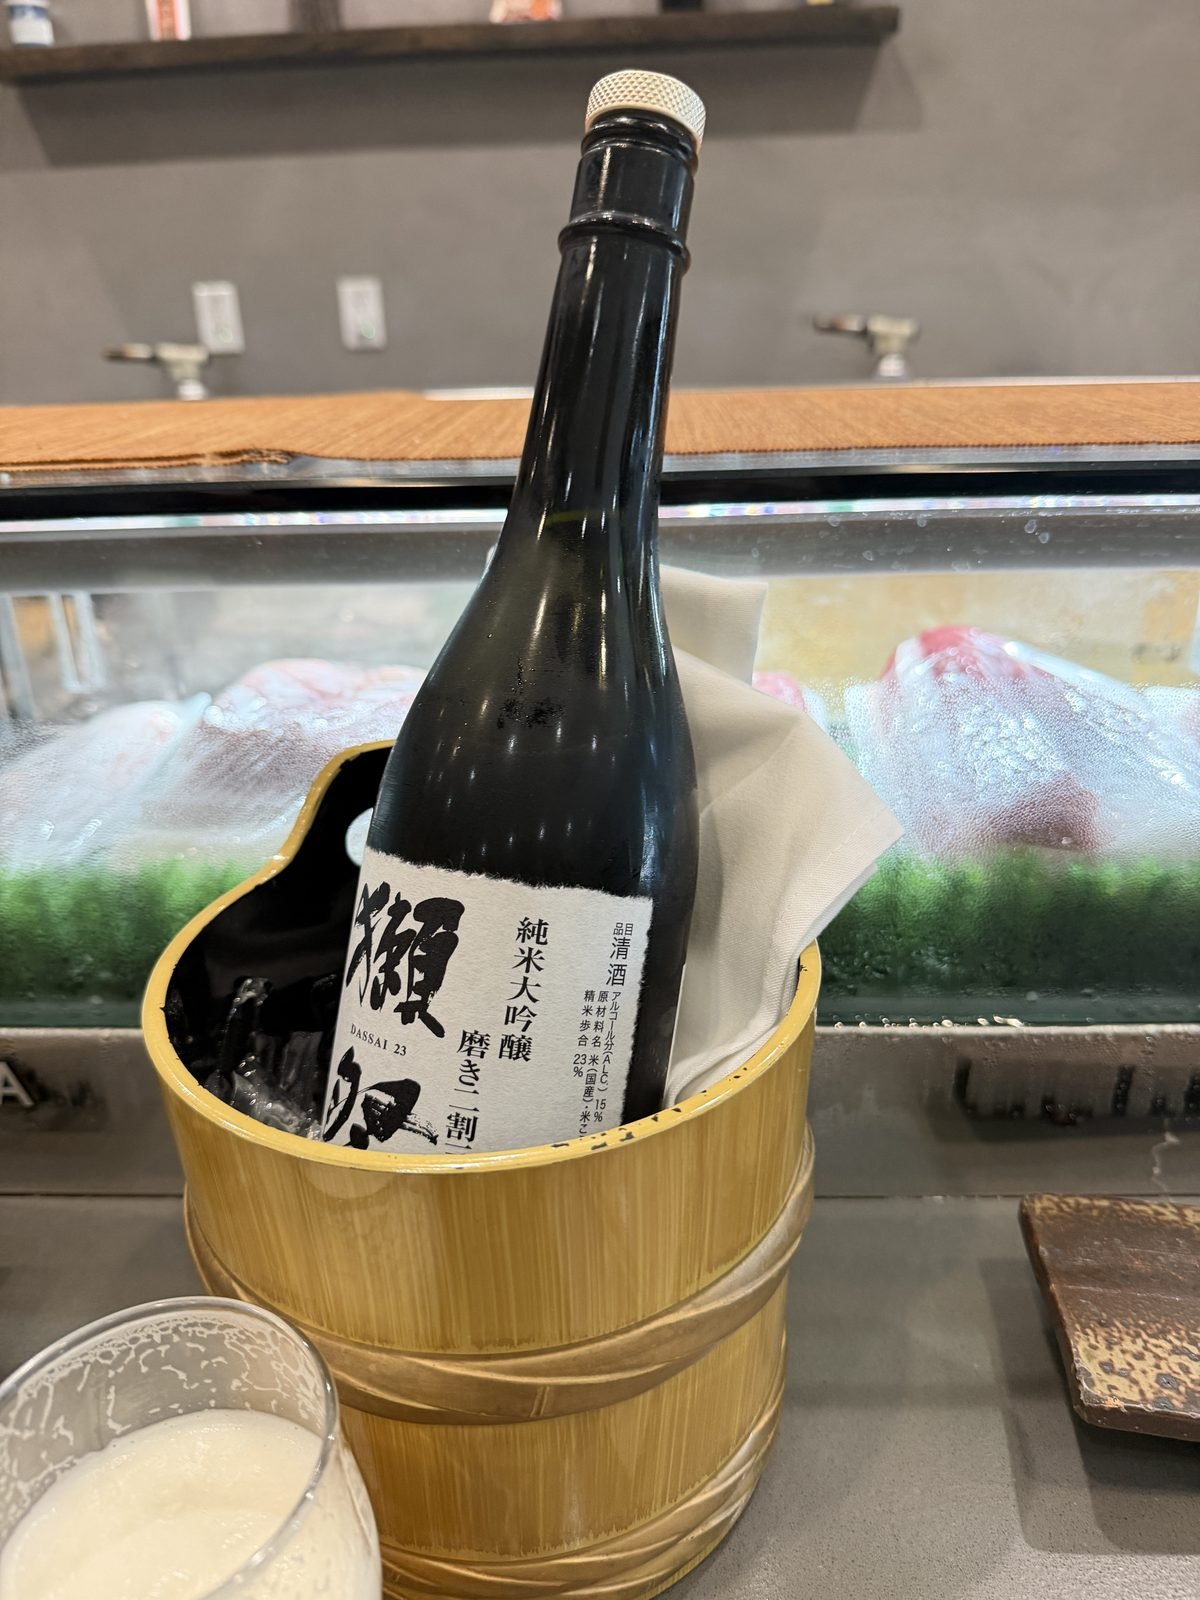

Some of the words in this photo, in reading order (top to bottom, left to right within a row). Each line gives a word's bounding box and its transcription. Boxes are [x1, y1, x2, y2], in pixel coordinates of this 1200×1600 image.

[498, 916, 549, 1063] 純米大吟醸
[350, 1023, 388, 1050] DASSAI
[393, 1043, 407, 1057] 23
